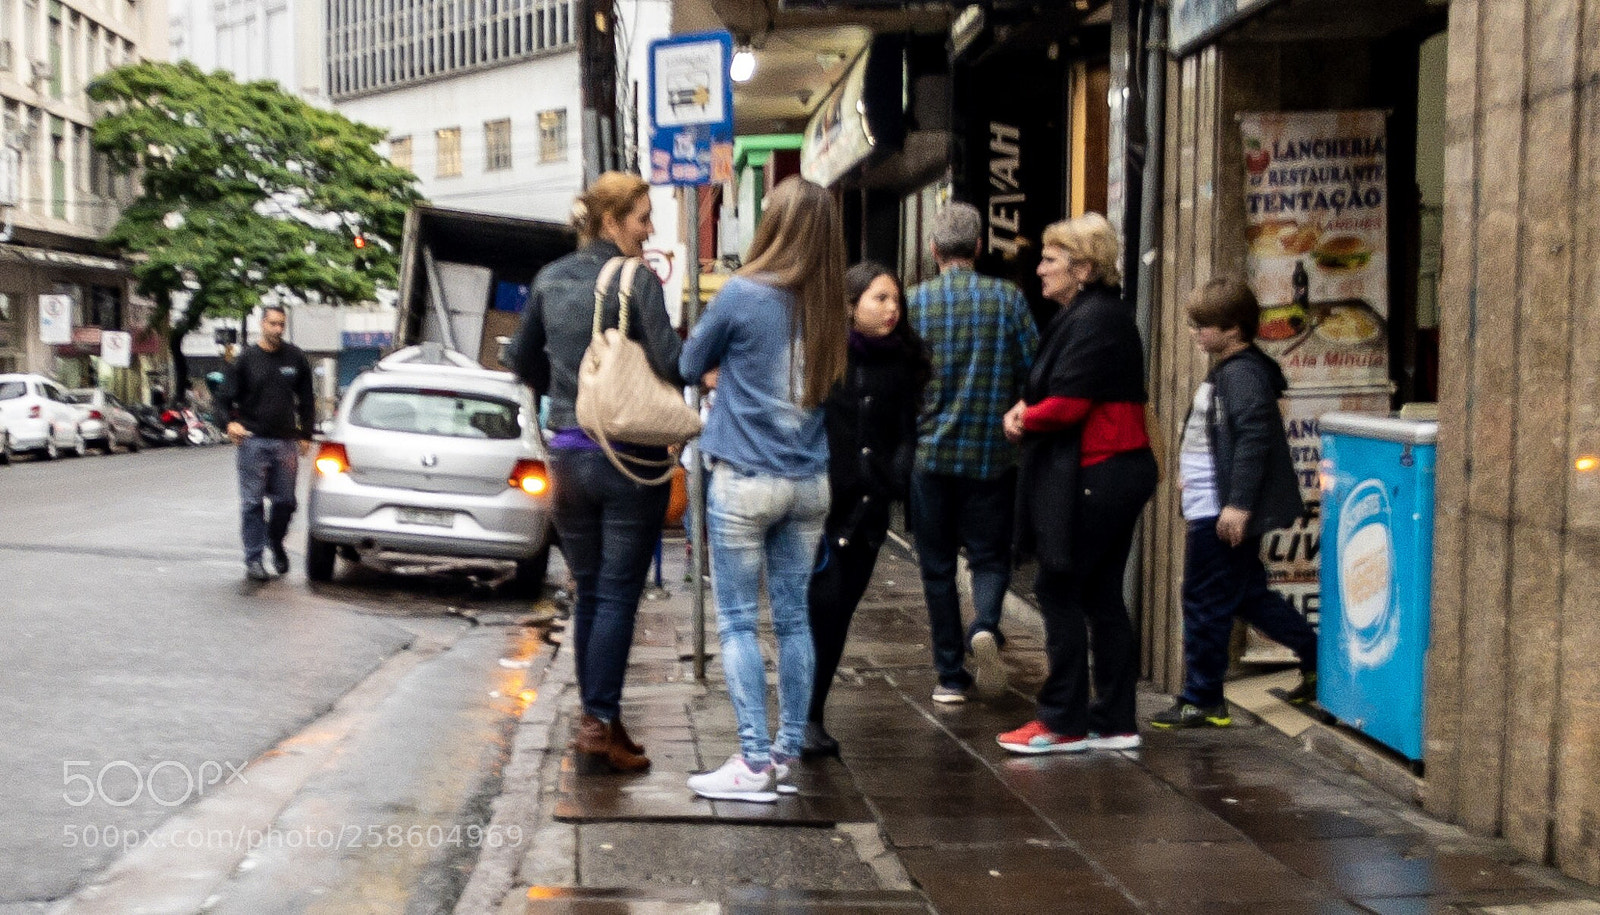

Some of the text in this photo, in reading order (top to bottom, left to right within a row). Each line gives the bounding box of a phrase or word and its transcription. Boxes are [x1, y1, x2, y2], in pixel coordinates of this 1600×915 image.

[1272, 137, 1384, 161] LANCHERIA
[988, 120, 1026, 255] TEVAH
[1268, 163, 1384, 187] RESTAURANTE
[1247, 184, 1382, 215] TENTAÇÃO
[1267, 532, 1321, 562] LIV
